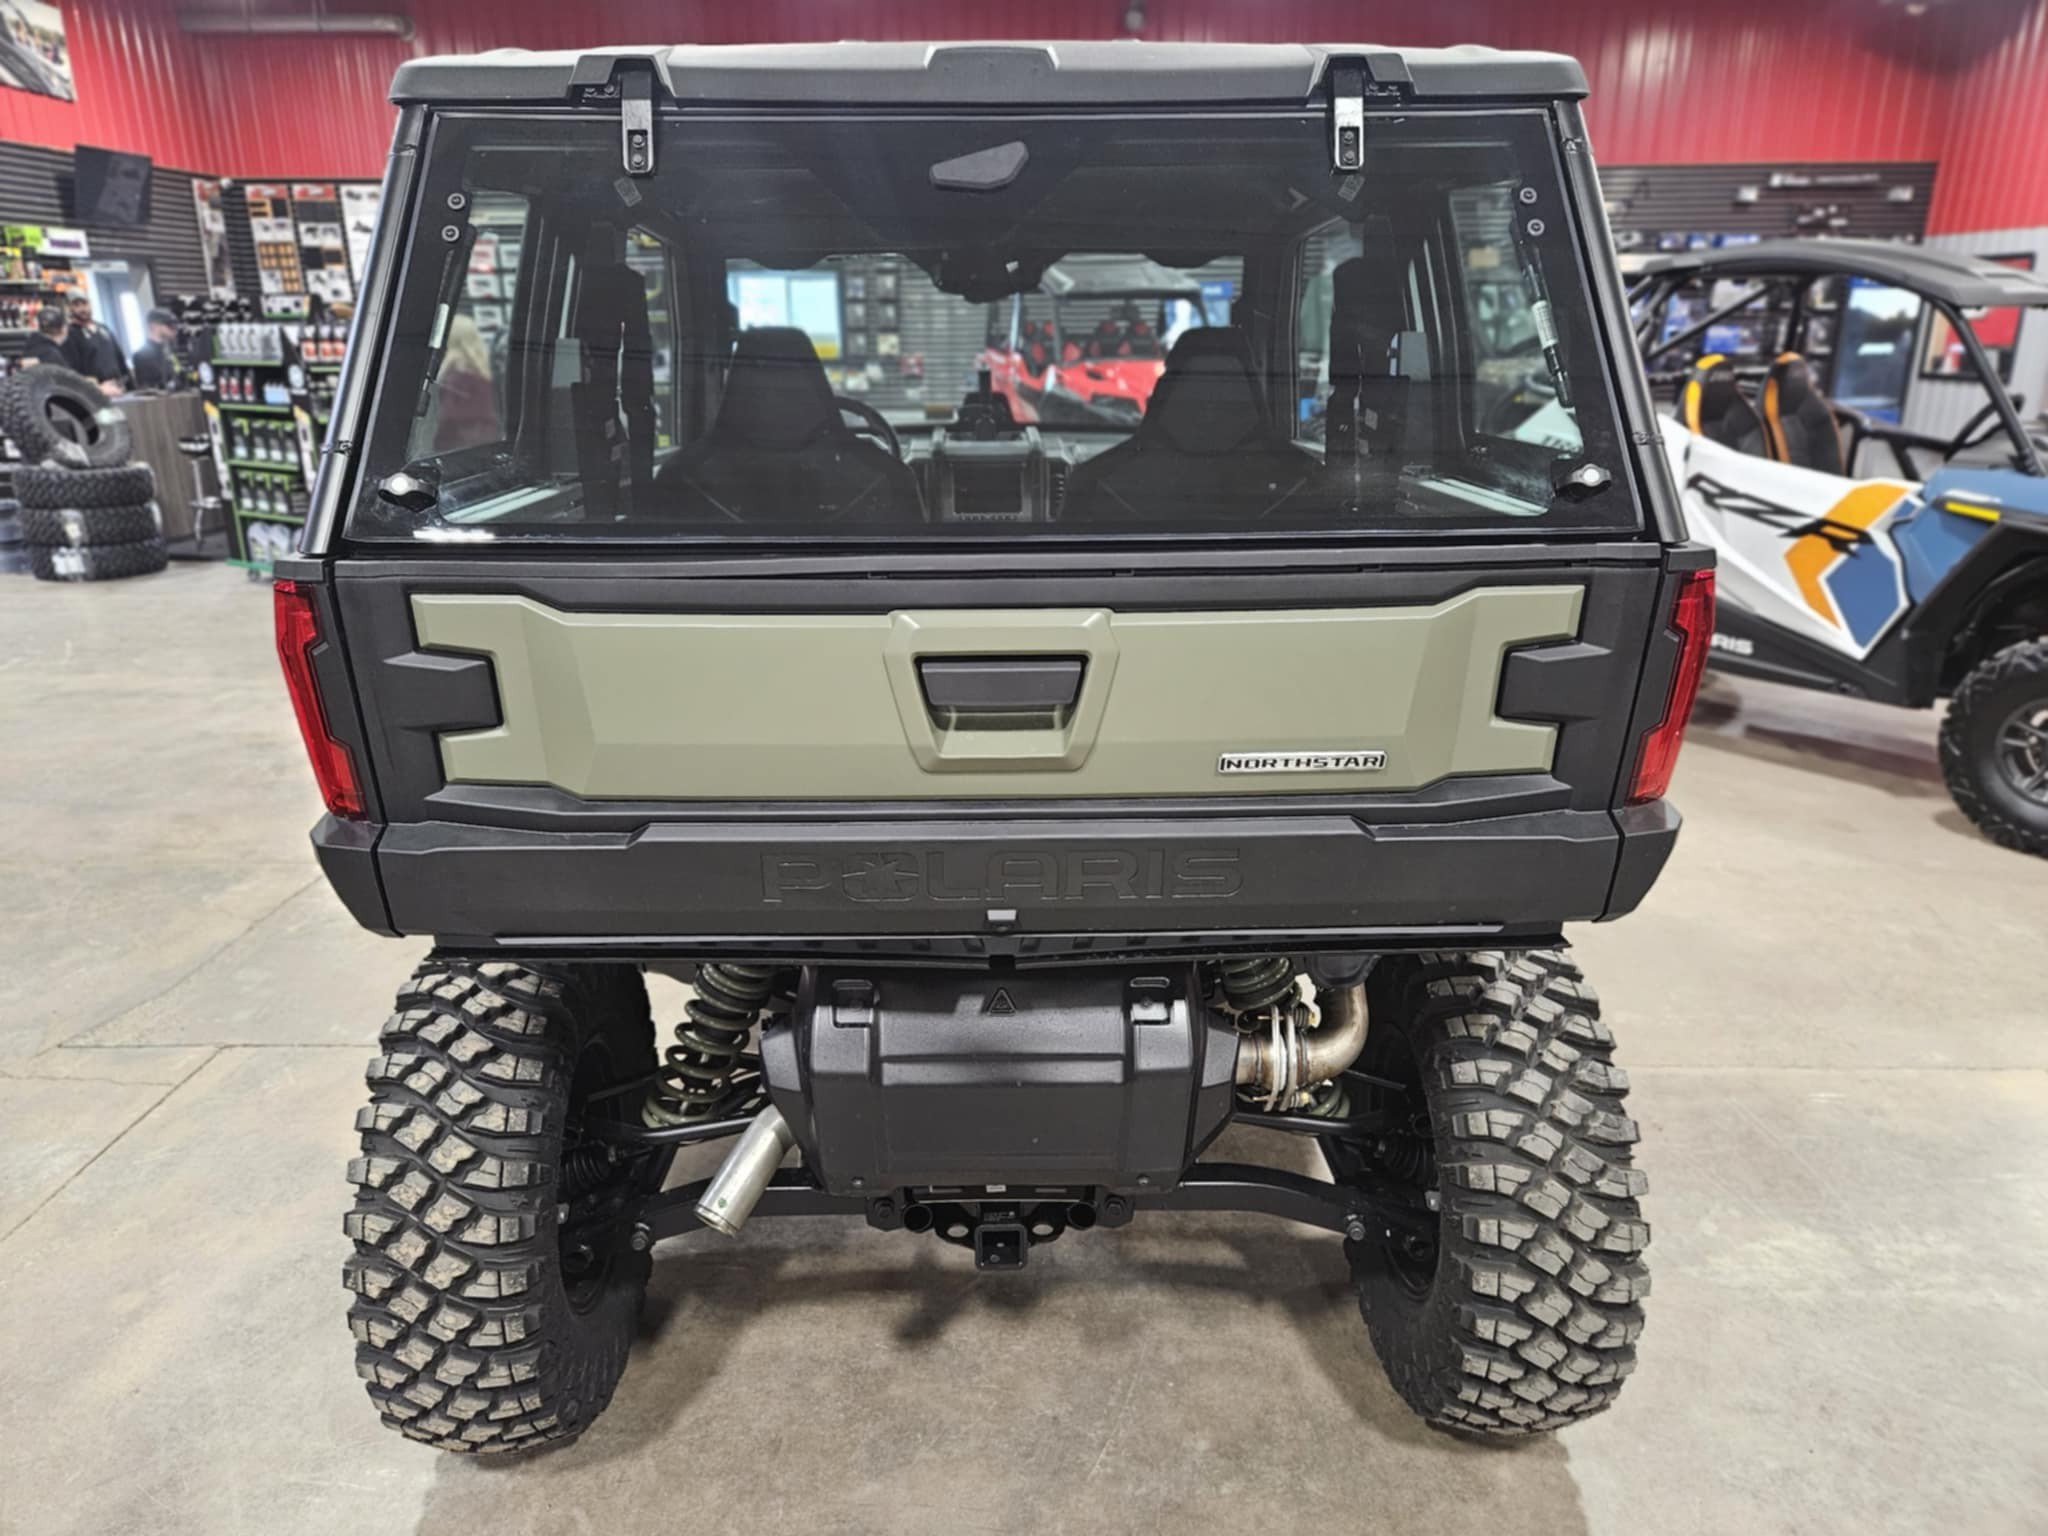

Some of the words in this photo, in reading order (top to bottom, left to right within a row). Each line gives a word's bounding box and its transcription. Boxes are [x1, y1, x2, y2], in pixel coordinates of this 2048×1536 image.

[1711, 633, 1754, 655] RIS
[1225, 755, 1380, 770] NORTHSTAR
[761, 848, 1244, 903] POLARIS
